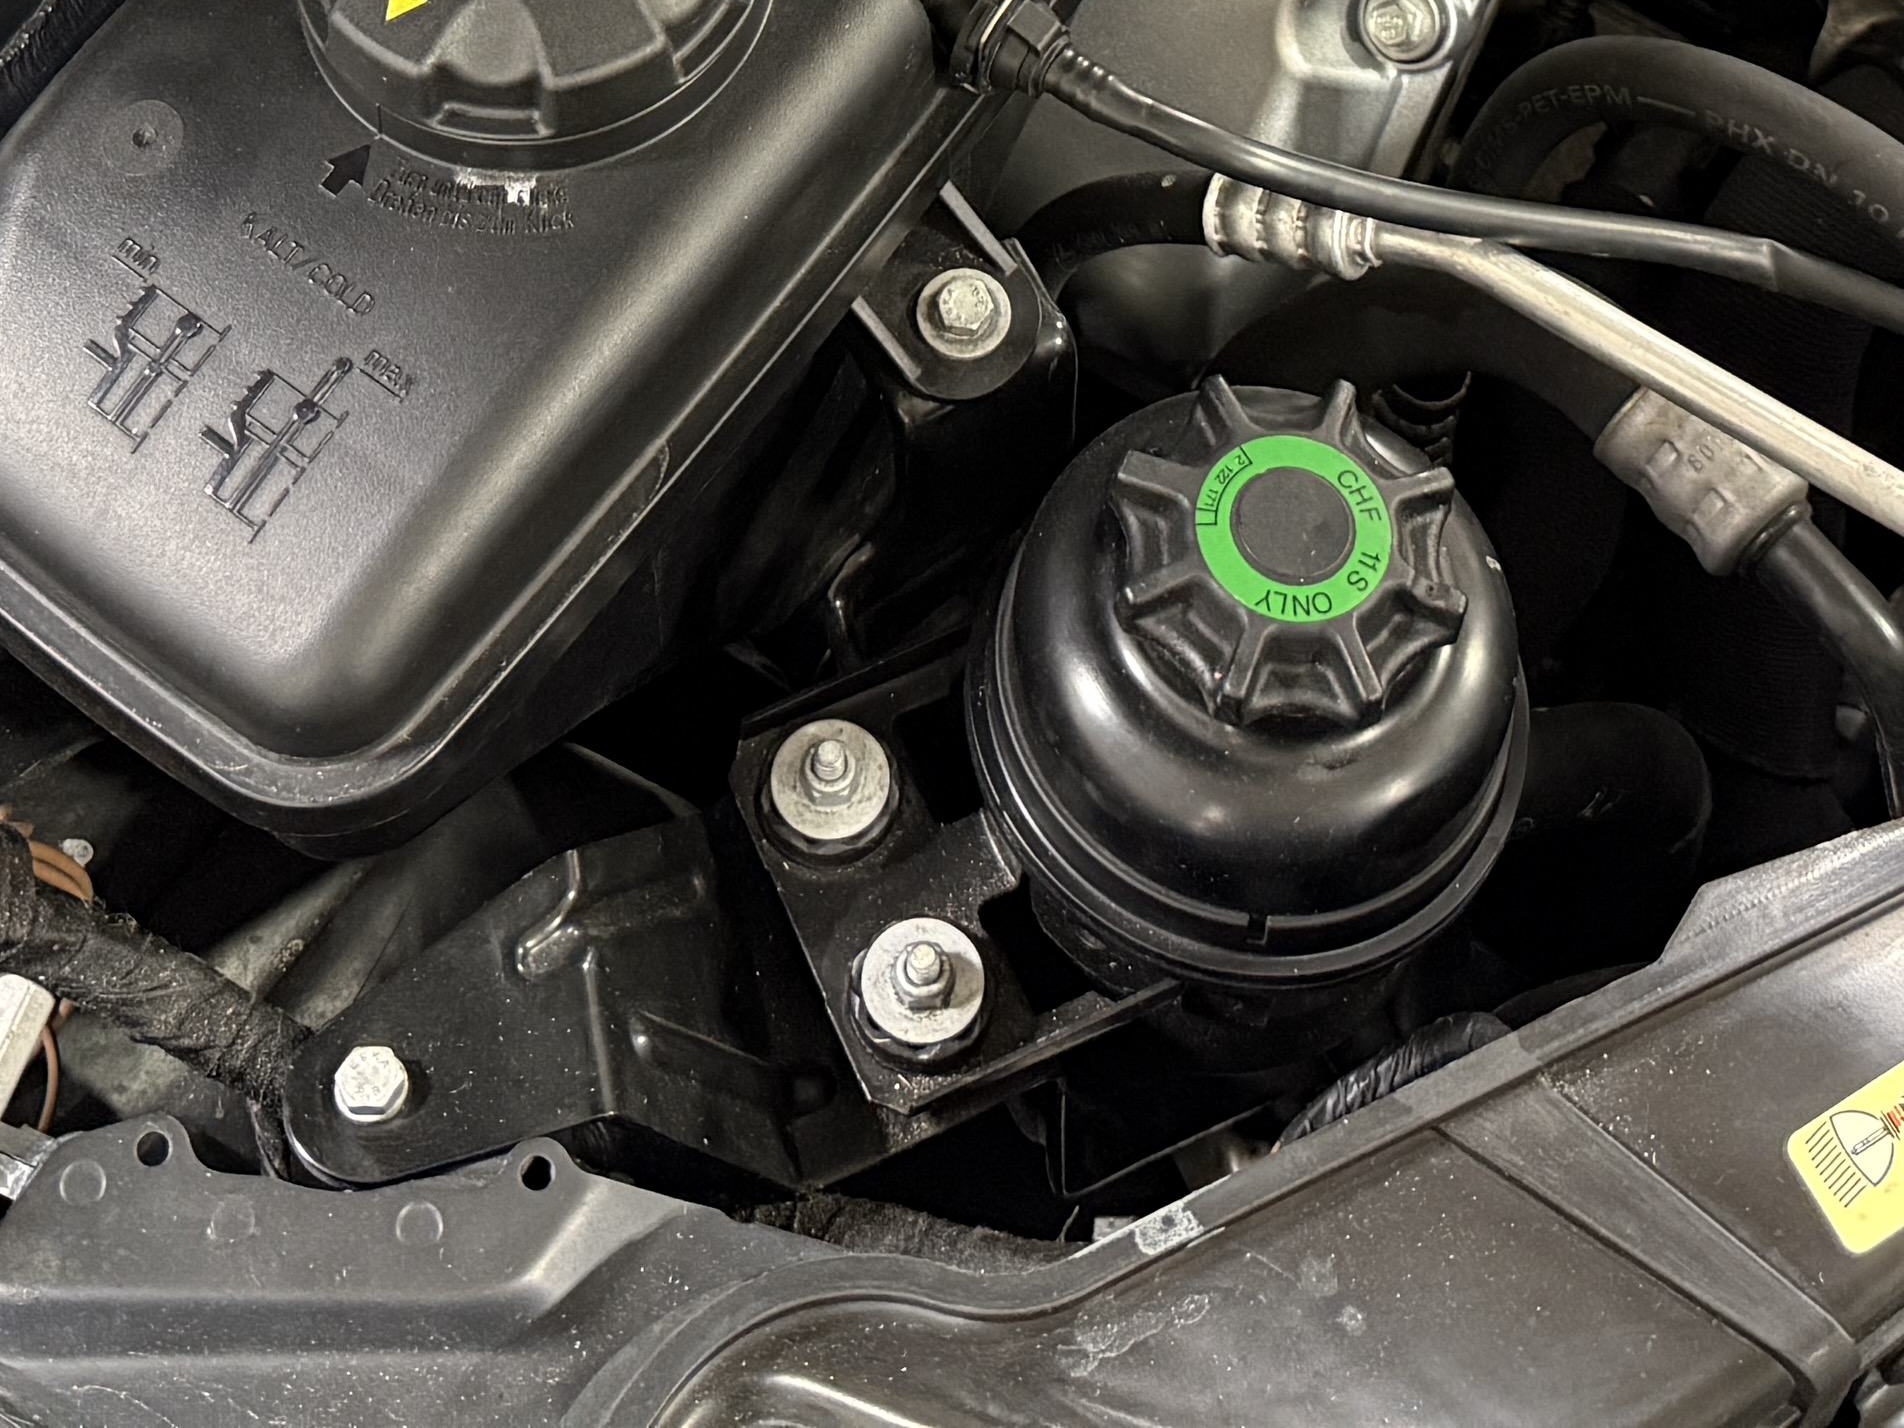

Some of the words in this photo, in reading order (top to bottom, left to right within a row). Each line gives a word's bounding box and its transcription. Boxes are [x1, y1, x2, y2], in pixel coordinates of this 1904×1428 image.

[1235, 454, 1246, 466] 2
[1337, 469, 1382, 522] CHF
[1255, 589, 1333, 616] ONLY
